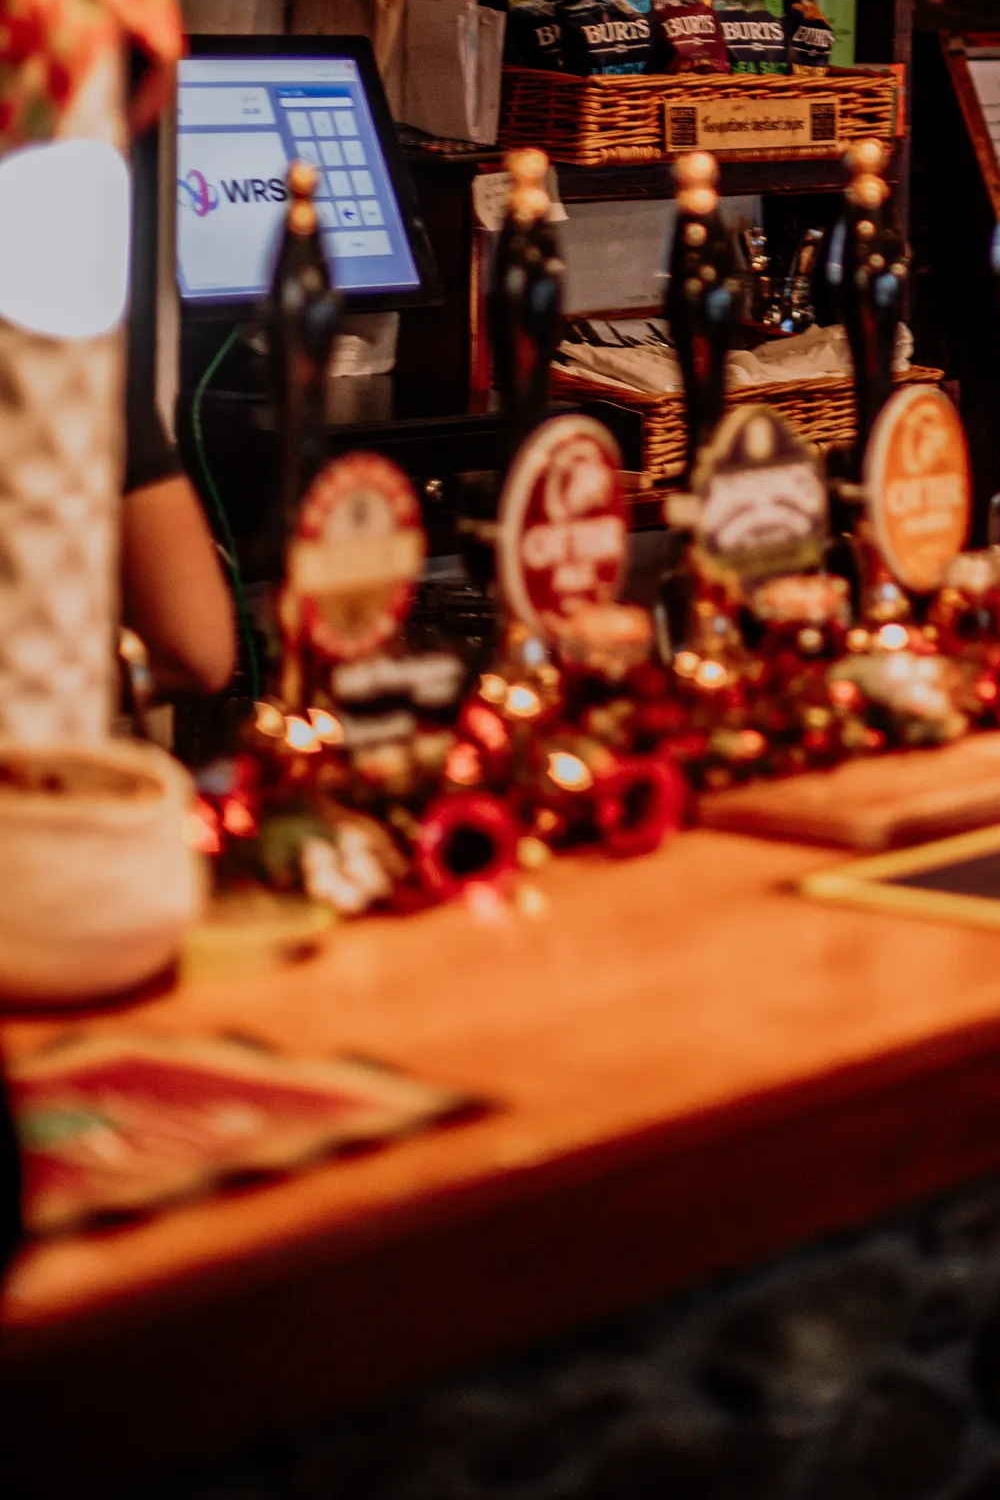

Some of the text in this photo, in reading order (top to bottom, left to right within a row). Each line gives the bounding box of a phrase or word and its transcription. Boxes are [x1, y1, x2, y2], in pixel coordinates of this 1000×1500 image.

[582, 18, 651, 45] BURTS
[661, 15, 717, 39] BURTS
[721, 21, 785, 42] BURTS
[792, 26, 837, 49] BURTS
[220, 177, 287, 203] WRS
